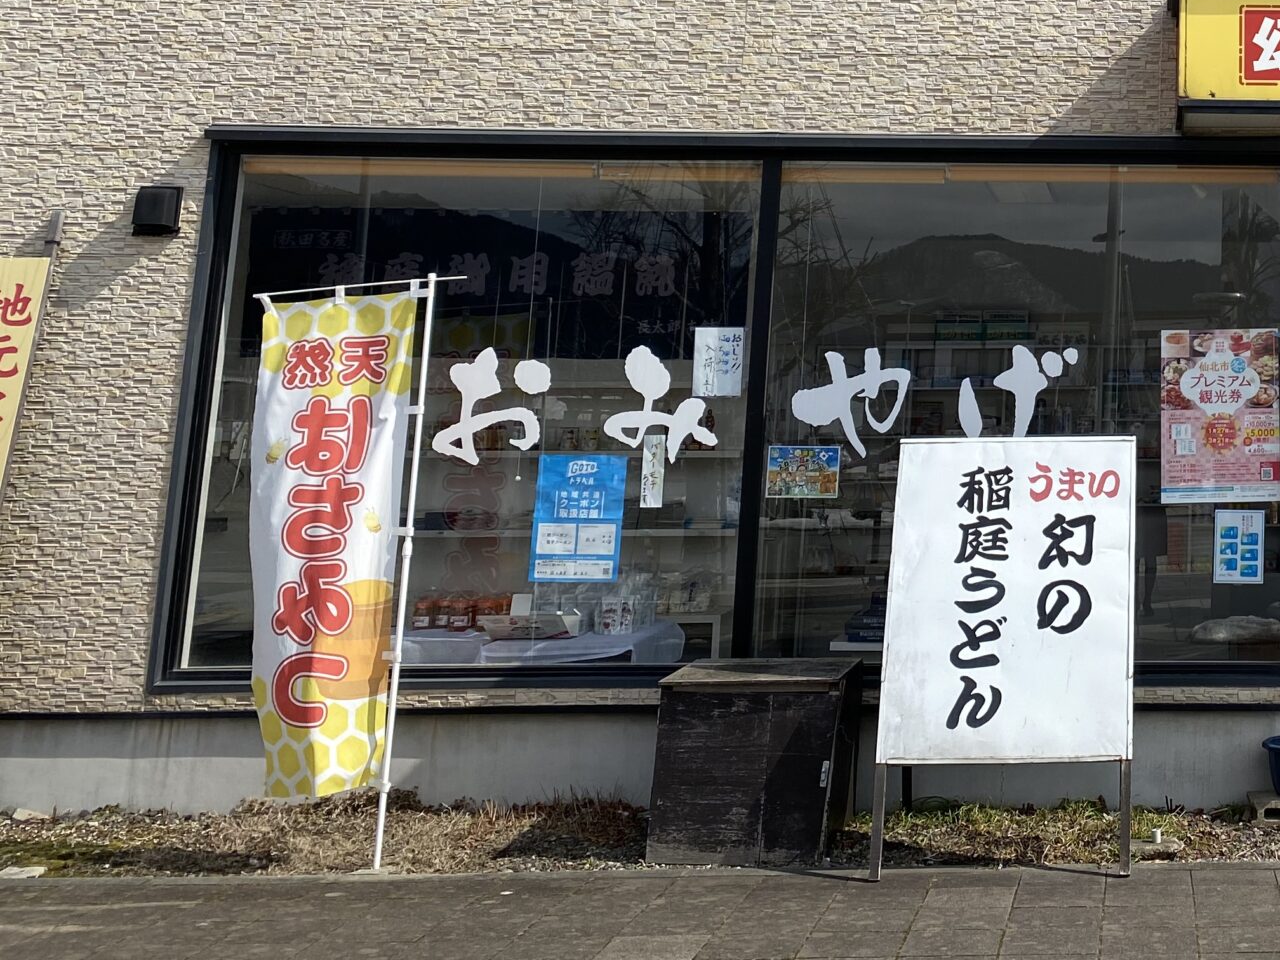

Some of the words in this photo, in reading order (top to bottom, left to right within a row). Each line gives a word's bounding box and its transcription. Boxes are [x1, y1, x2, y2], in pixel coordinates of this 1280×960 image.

[1200, 361, 1229, 372] 仙北市
[1190, 374, 1252, 389] プレミアム
[432, 344, 1078, 465] おみやげ
[1199, 389, 1242, 404] 観光券
[1028, 462, 1121, 503] うまい
[560, 499, 600, 508] クーポン
[1037, 513, 1096, 635] 幻の
[946, 466, 1014, 730] 稲庭うどん
